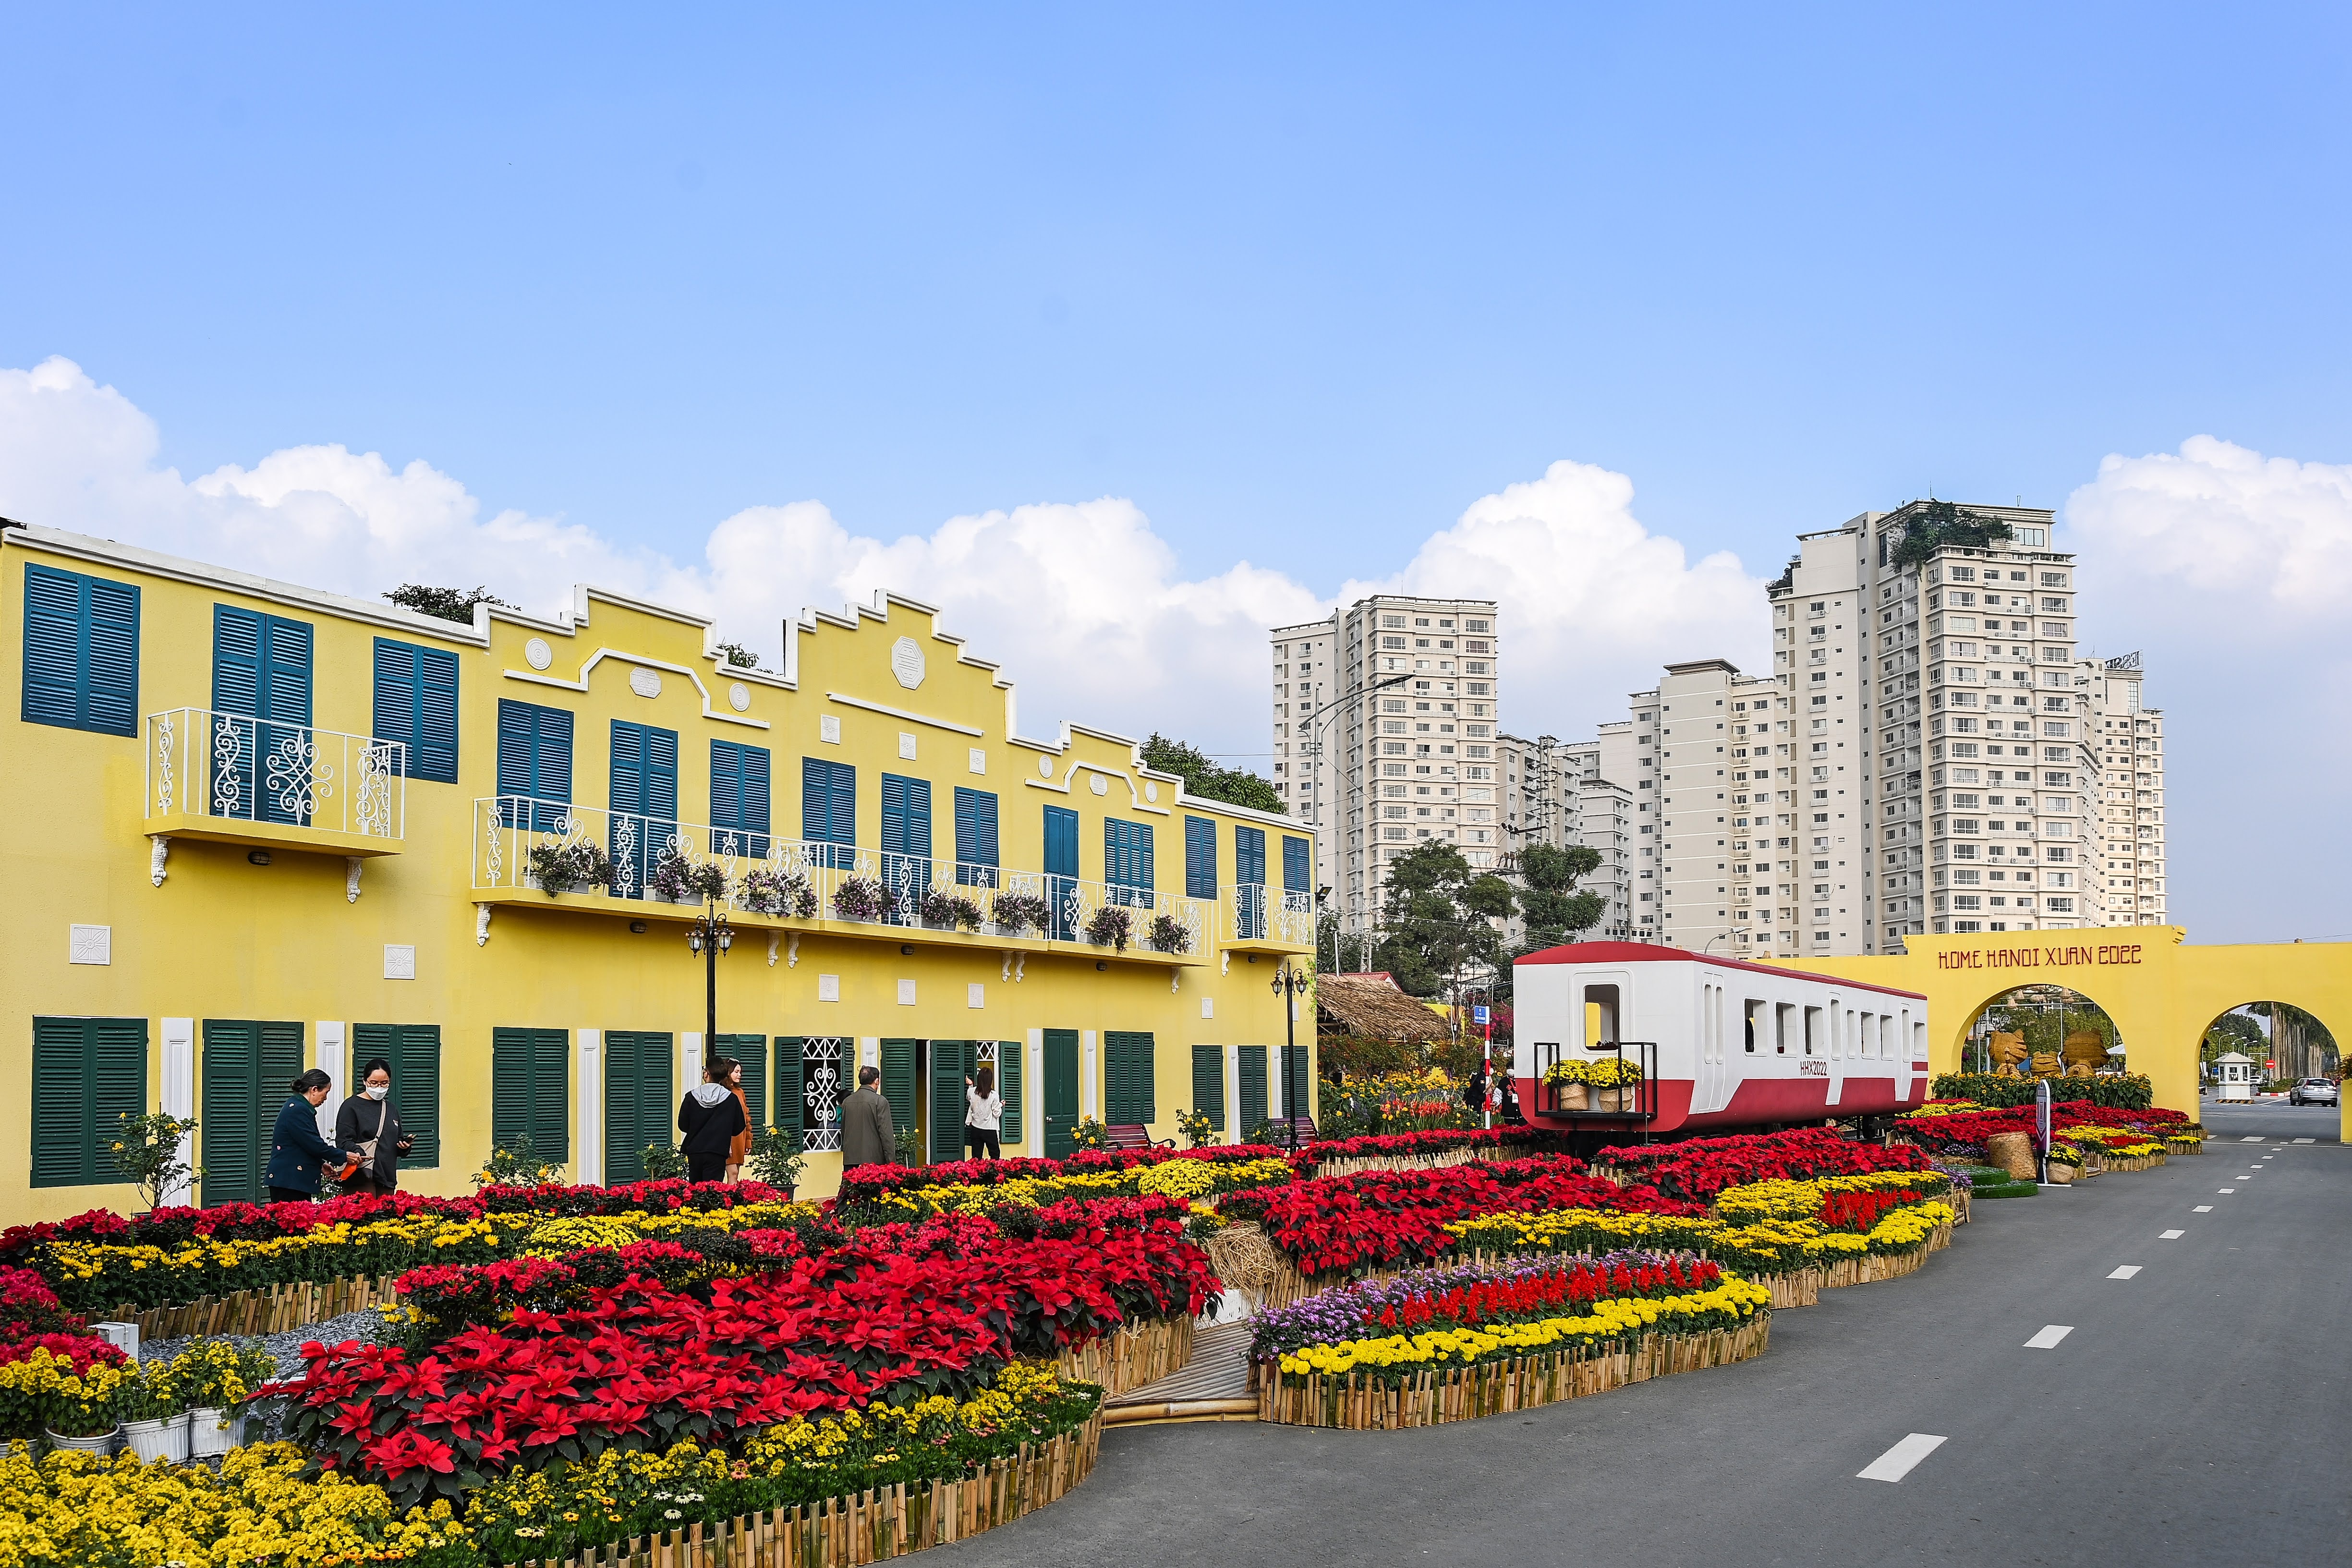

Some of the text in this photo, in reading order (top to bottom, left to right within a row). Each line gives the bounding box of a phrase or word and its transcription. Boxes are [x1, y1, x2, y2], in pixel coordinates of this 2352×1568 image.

[1939, 945, 2141, 969] HOME HANOI XUAN 2022
[1800, 1060, 1827, 1076] HHX2022
